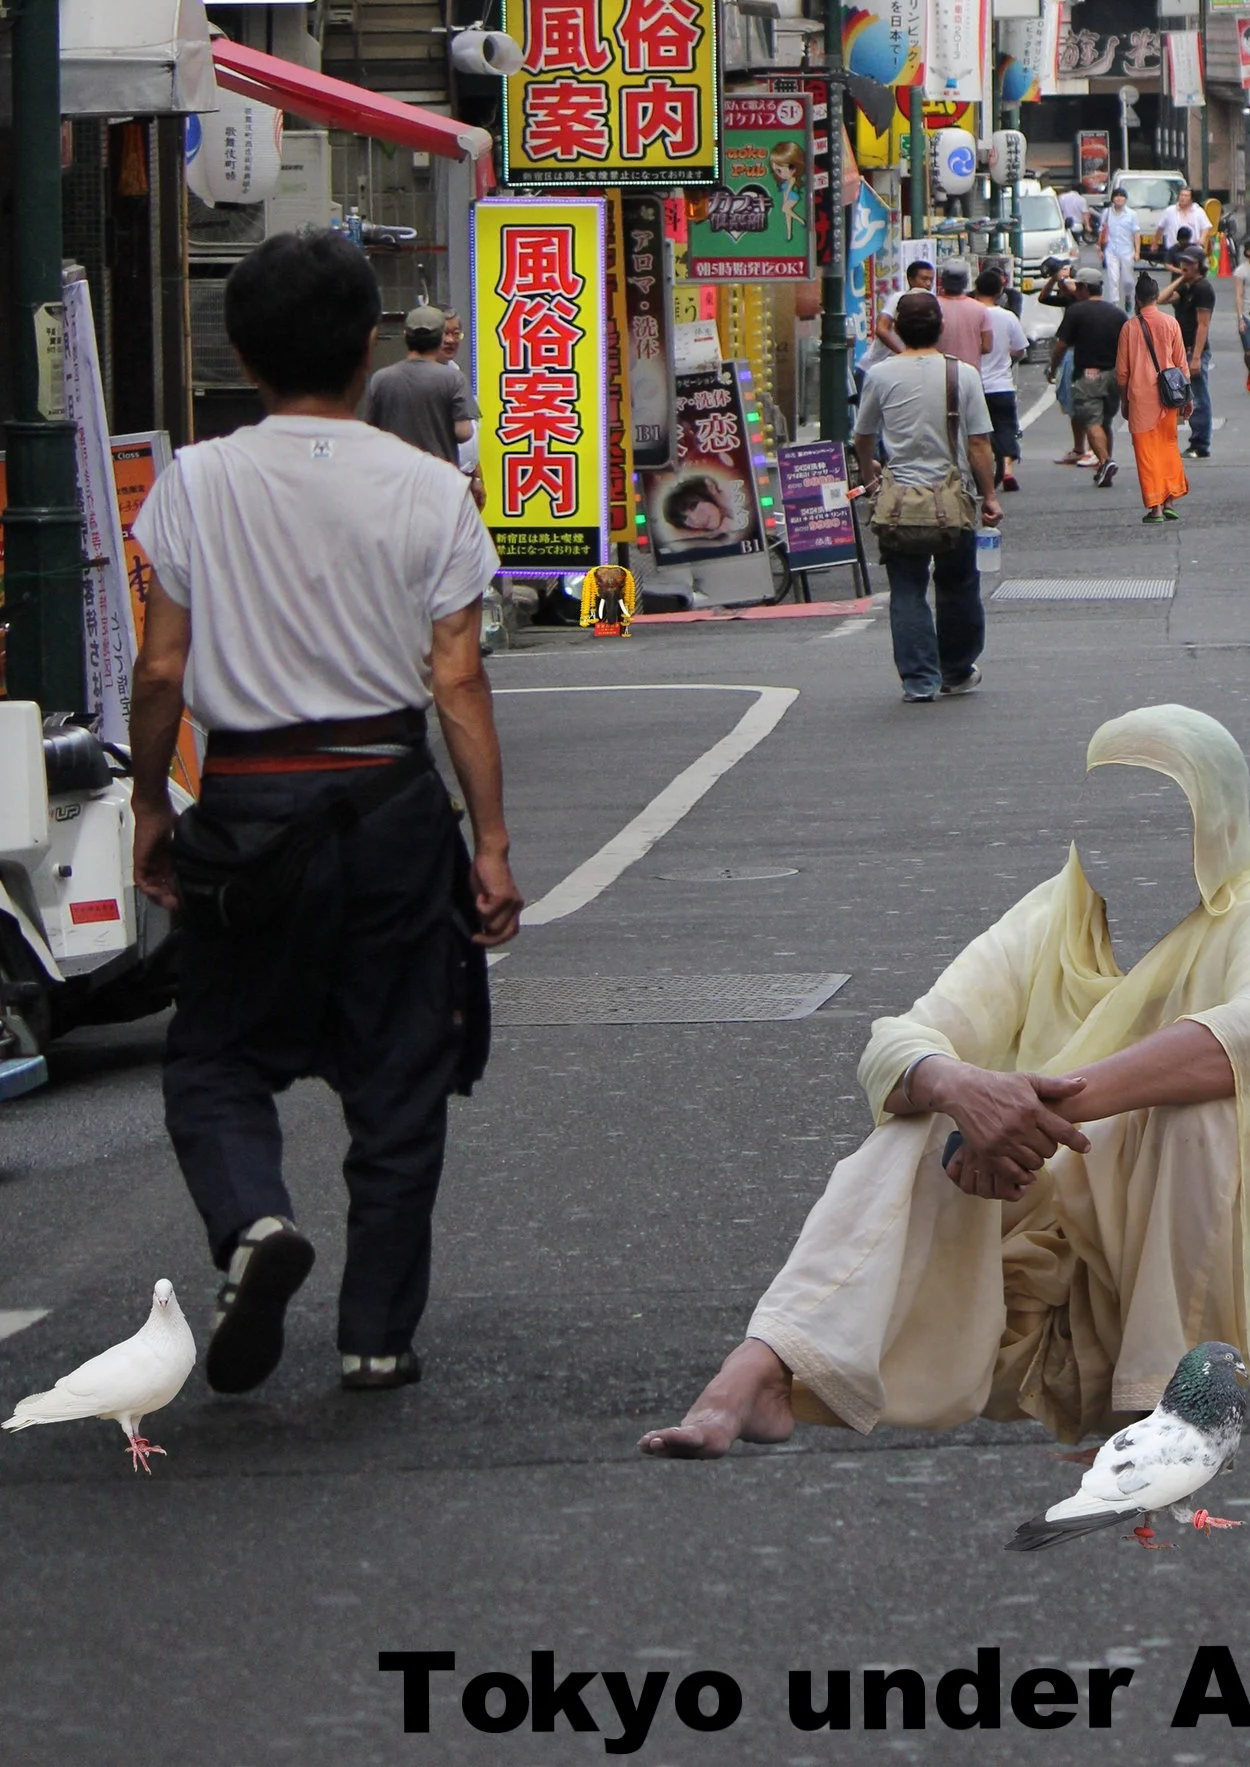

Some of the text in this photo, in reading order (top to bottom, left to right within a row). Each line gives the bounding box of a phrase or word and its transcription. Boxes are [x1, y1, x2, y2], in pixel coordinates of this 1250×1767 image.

[779, 105, 799, 120] 5F
[523, 79, 702, 162] 案内
[731, 164, 767, 178] Pub
[495, 223, 585, 519] 風俗案内
[496, 532, 585, 546] 新宿区は路上喫煙
[741, 540, 762, 554] B1
[55, 804, 80, 822] UP
